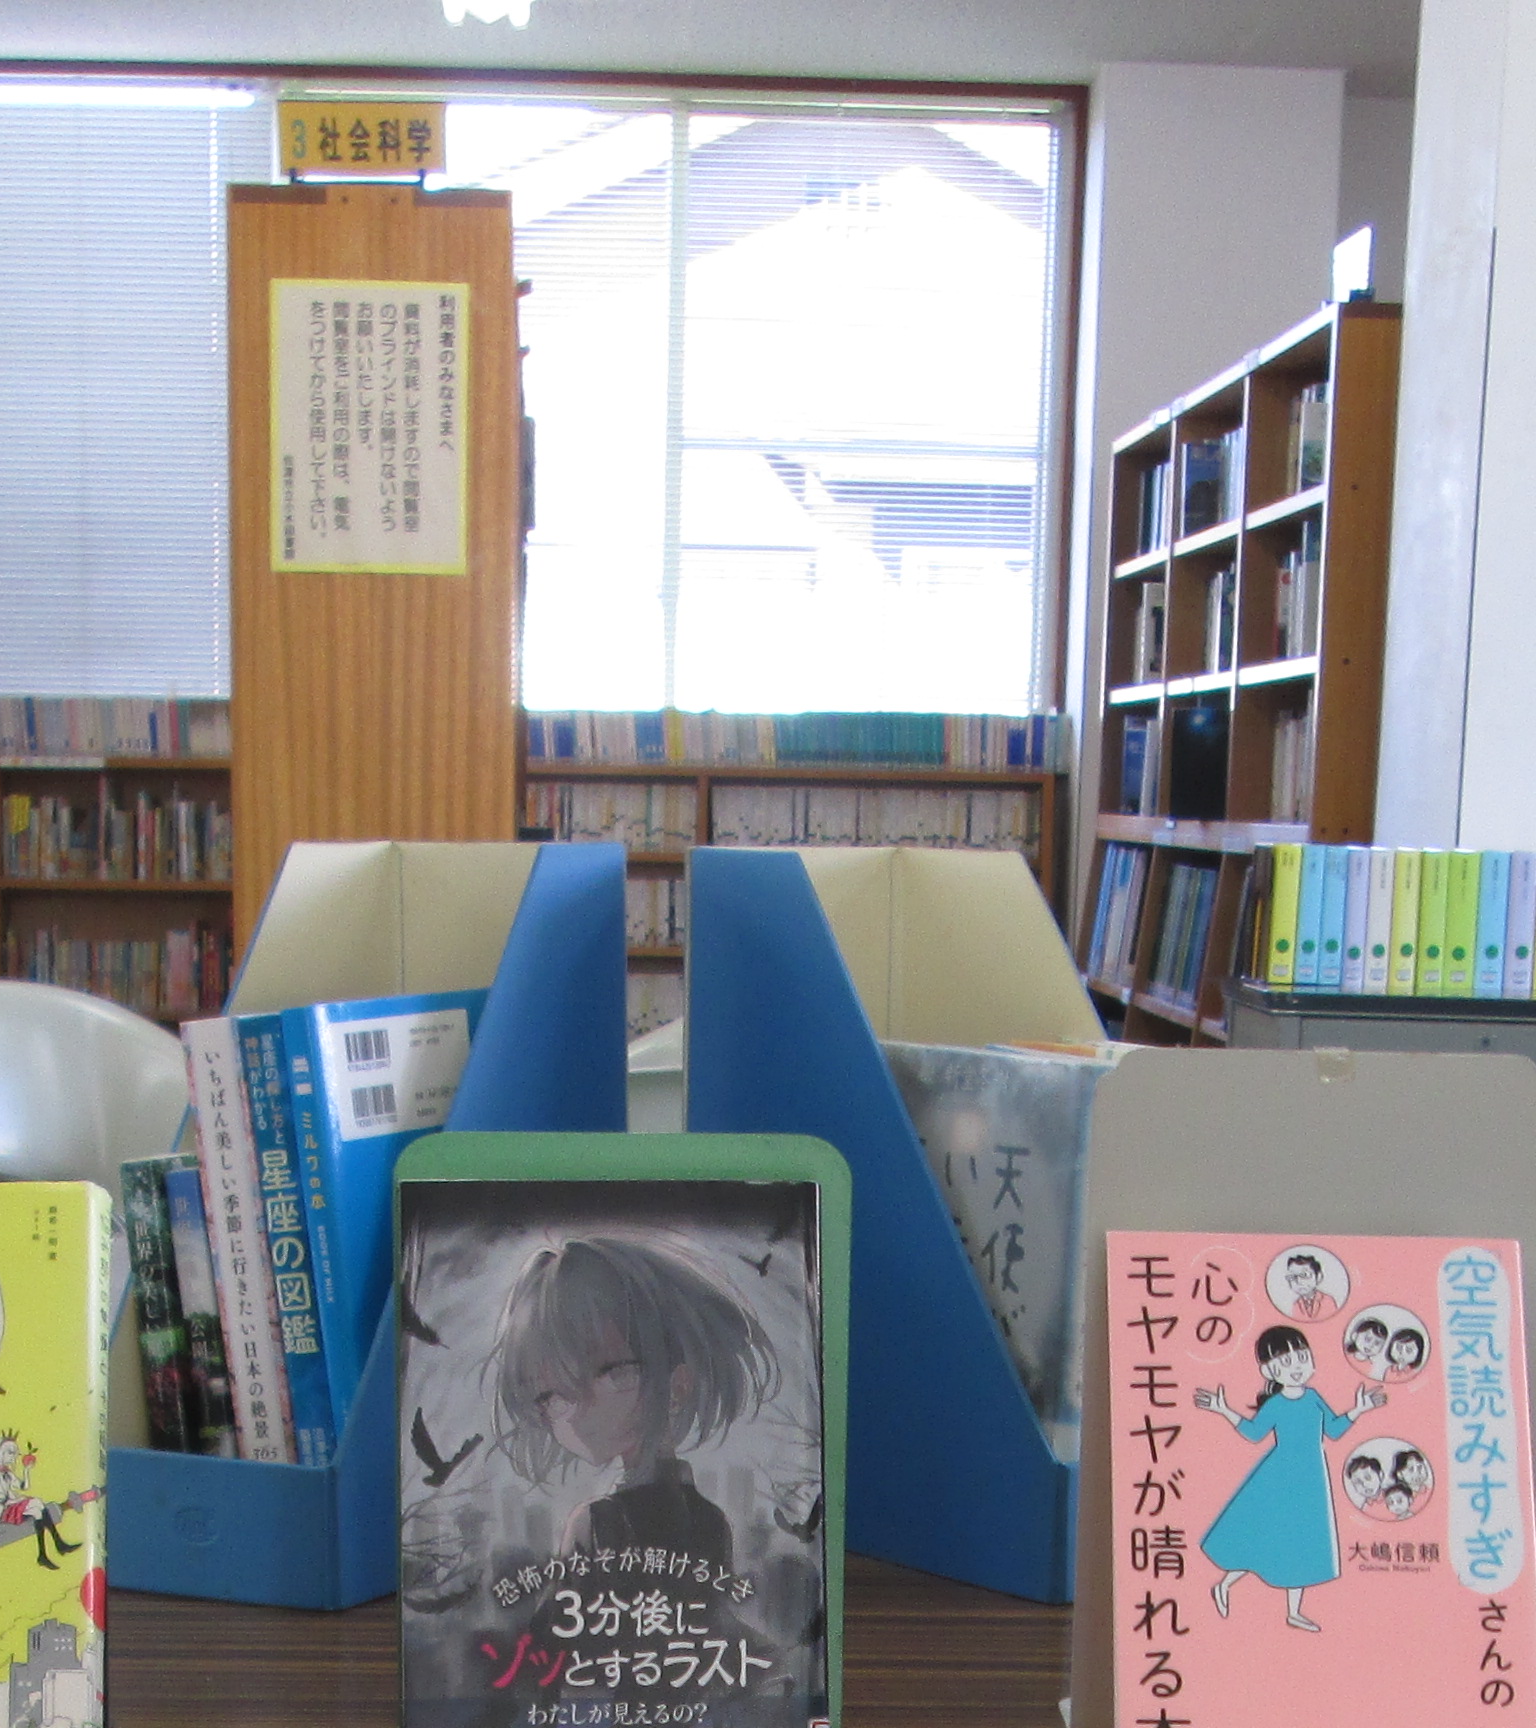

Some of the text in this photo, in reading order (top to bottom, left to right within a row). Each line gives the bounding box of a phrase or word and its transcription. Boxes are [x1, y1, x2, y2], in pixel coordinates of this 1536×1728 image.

[320, 118, 431, 162] 社会科学
[262, 1149, 318, 1356] 星座の図鑑
[1191, 1262, 1238, 1346] 心の
[492, 1547, 756, 1607] 恐怖のなぞが解けるとき
[552, 1589, 710, 1638] 3分後に
[481, 1634, 773, 1688] ゾッとするラスト
